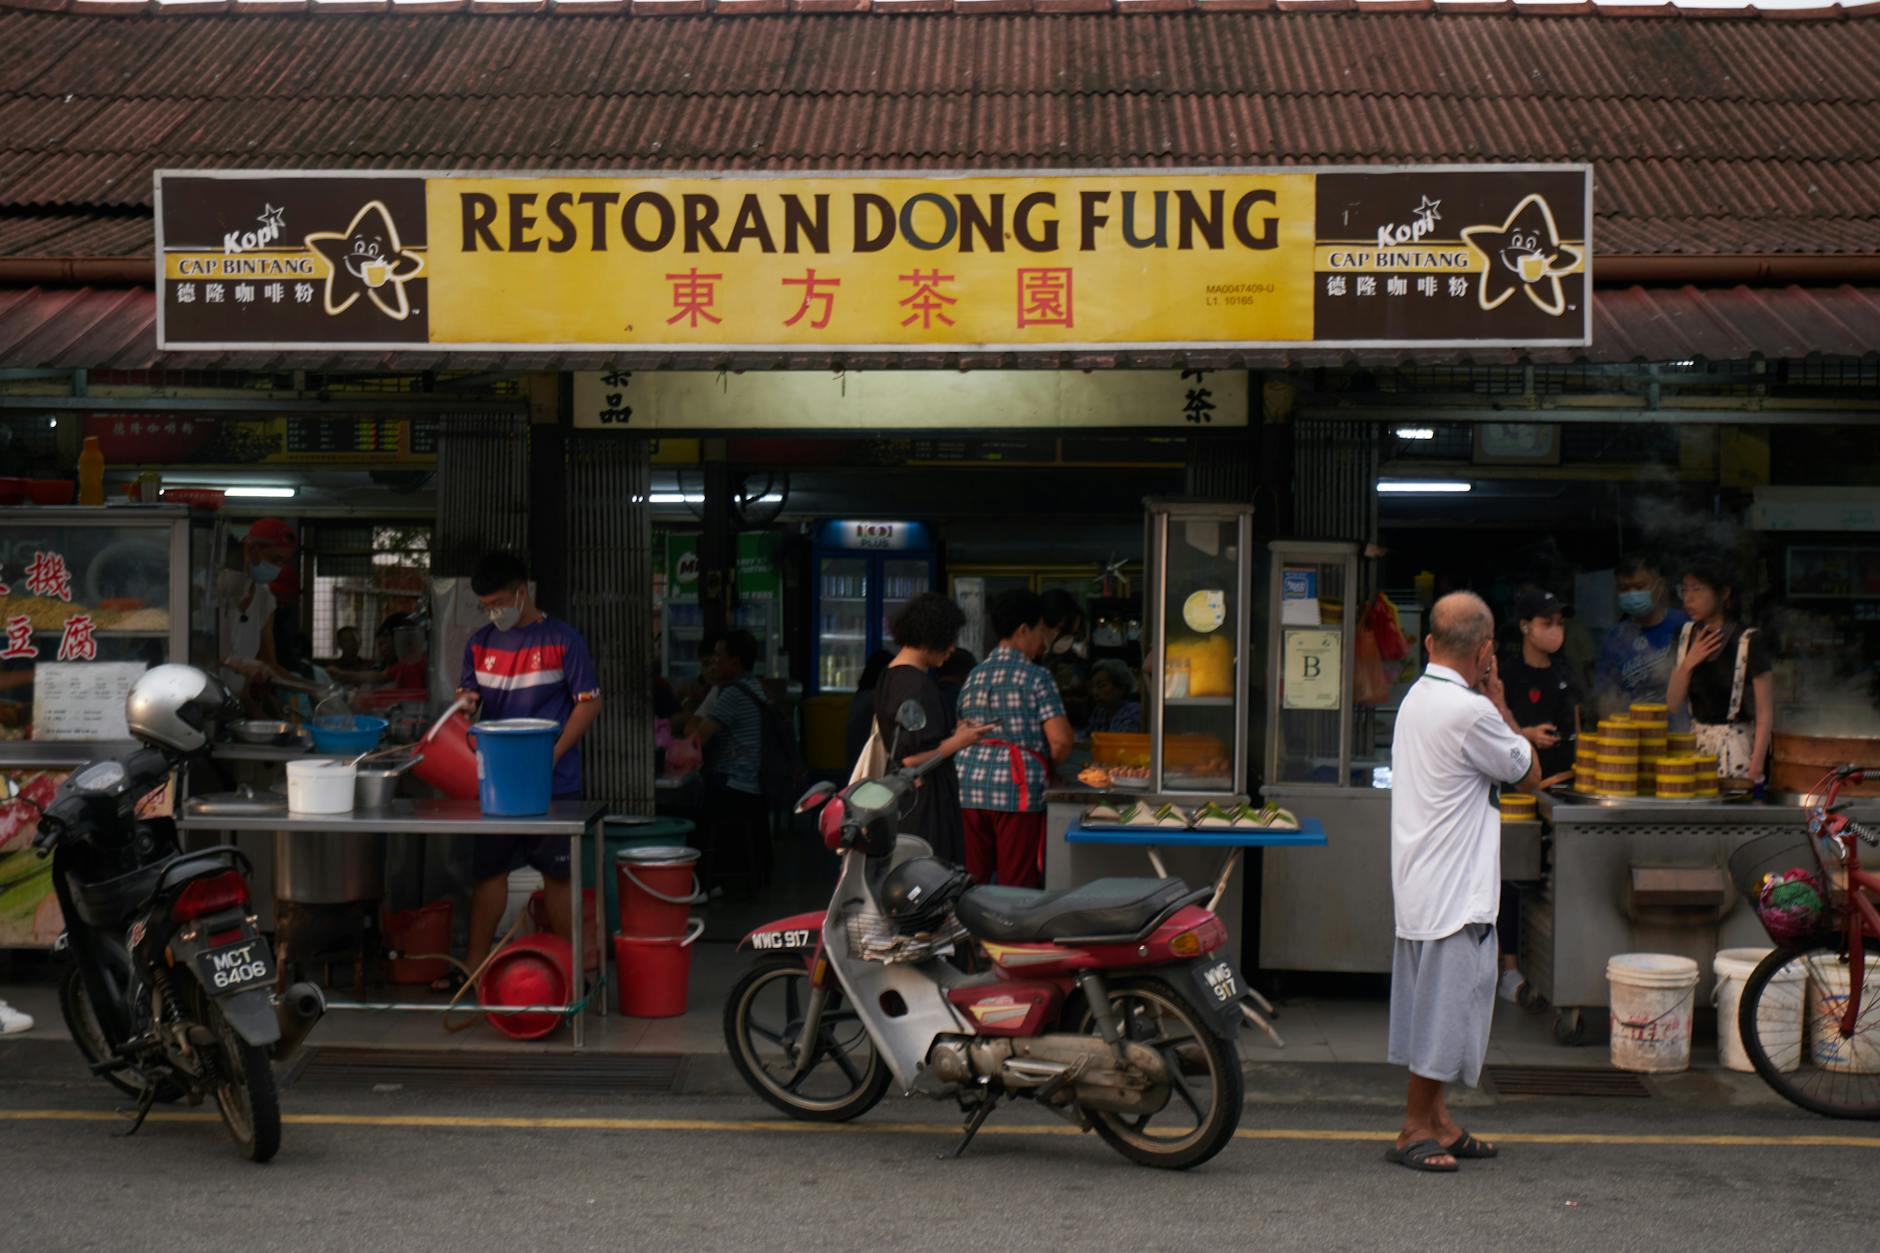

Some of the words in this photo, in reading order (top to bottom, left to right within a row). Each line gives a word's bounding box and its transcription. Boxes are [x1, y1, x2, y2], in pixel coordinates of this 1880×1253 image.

[461, 191, 829, 253] RESTORAN
[853, 191, 1060, 252] DONG
[1080, 189, 1279, 251] FUNG
[1376, 209, 1436, 249] Kopi
[223, 216, 279, 255] Kopi
[179, 258, 217, 275] CAP
[223, 257, 315, 276] BINTANG
[1329, 252, 1369, 268] CAP
[1375, 252, 1469, 268] BINTANG
[665, 266, 1074, 330] 東方茶園
[1302, 656, 1321, 678] B
[784, 929, 810, 948] 917
[213, 946, 251, 972] MCT
[213, 960, 267, 988] 6406
[1213, 976, 1237, 1002] 917
